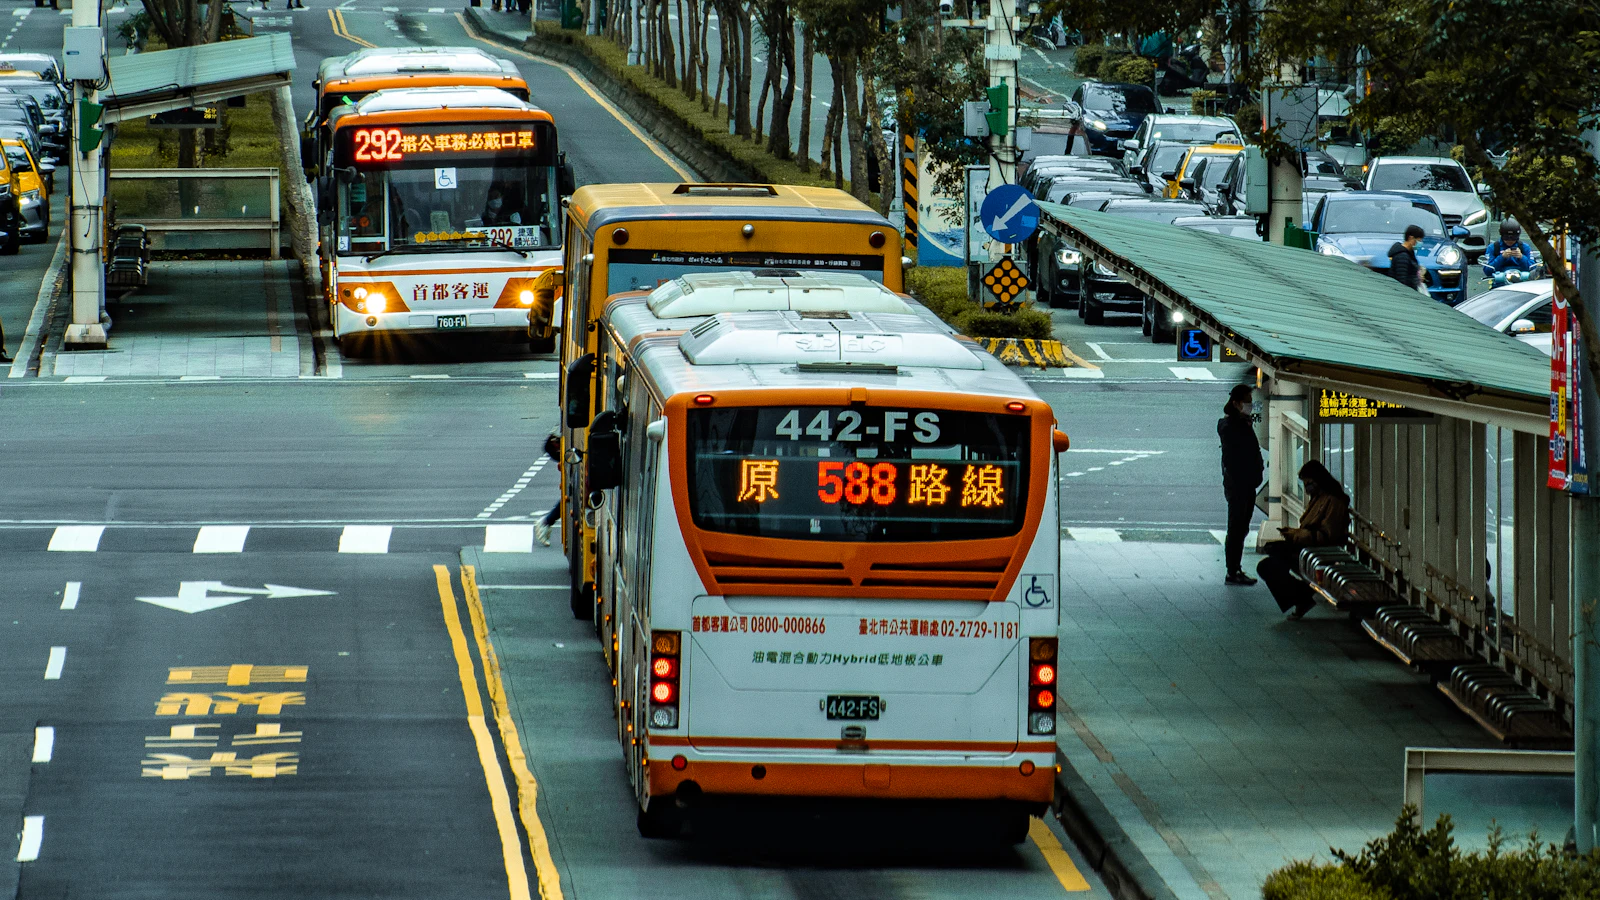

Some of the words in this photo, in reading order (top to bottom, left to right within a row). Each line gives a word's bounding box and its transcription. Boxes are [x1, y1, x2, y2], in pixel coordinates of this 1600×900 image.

[355, 129, 402, 160] 292
[401, 131, 534, 152] 搭公車務必戴口罩
[490, 228, 513, 247] 292
[412, 281, 490, 301] 首都客運
[775, 409, 941, 443] 442-FS
[737, 459, 780, 503] 原
[817, 460, 897, 505] 588
[908, 463, 1004, 507] 路線
[692, 615, 748, 633] 首都客運公司
[751, 615, 826, 635] 0800-000866
[858, 618, 940, 637] 臺北市公共運輸處
[941, 619, 1019, 640] 02-2729-1181
